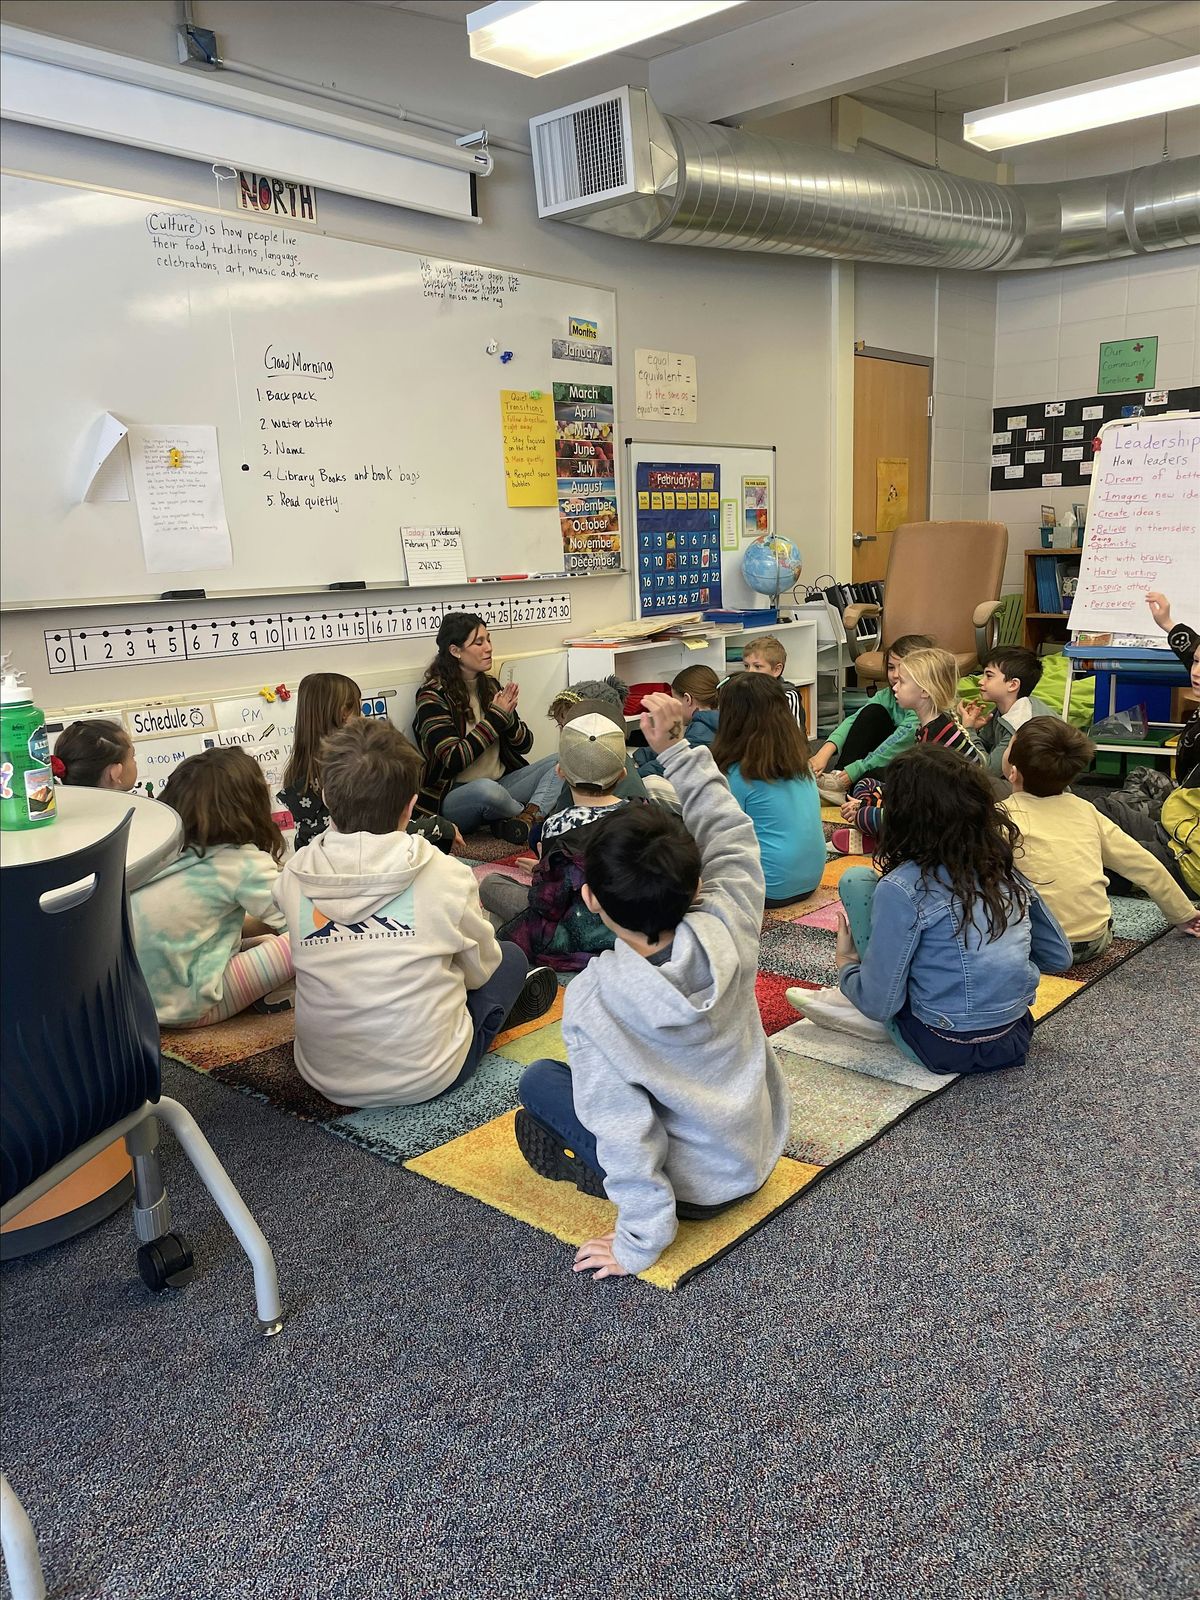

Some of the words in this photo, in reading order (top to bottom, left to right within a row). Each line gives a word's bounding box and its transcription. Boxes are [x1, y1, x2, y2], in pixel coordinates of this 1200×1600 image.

[239, 171, 314, 220] NORTH
[149, 213, 195, 234] Culture
[204, 225, 216, 235] is
[221, 220, 242, 238] how
[247, 230, 278, 246] people
[283, 230, 297, 246] live
[153, 236, 178, 250] their
[185, 238, 209, 257] food,
[156, 254, 220, 276] celebrations,
[226, 264, 245, 276] art,
[248, 265, 276, 277] music
[281, 269, 297, 278] and
[300, 272, 318, 280] more
[572, 325, 597, 339] Months
[564, 343, 602, 363] January
[1103, 345, 1123, 357] Our
[264, 344, 290, 370] Good
[292, 352, 334, 379] Morning
[647, 352, 670, 371] equal
[638, 369, 682, 386] equivalent
[266, 390, 318, 405] Backpack
[569, 385, 599, 400] March
[655, 388, 665, 400] the
[504, 401, 544, 413] Transitions
[574, 405, 596, 421] April
[304, 416, 334, 428] bottle
[574, 421, 596, 439] May
[262, 443, 272, 455] 3.
[275, 440, 305, 455] Name
[573, 442, 596, 456] June
[1115, 430, 1200, 453] Leadership
[1113, 454, 1133, 467] How
[1143, 451, 1189, 466] leaders
[277, 467, 315, 487] Library
[318, 468, 347, 483] Books
[354, 465, 370, 481] and
[371, 465, 393, 481] book
[576, 461, 595, 477] July
[1104, 472, 1144, 485] Dream
[1152, 467, 1167, 480] of
[571, 480, 603, 496] August
[657, 473, 692, 488] February
[279, 490, 301, 508] Read
[1103, 490, 1149, 505] Imagine
[564, 499, 612, 515] September
[1097, 507, 1128, 518] Create
[1132, 507, 1161, 517] ideas
[572, 517, 609, 532] October
[1096, 524, 1127, 535] Believe
[1148, 522, 1197, 535] themselves
[443, 538, 458, 548] 2025
[569, 537, 615, 551] November
[644, 536, 649, 547] 2
[656, 536, 662, 547] 3
[680, 535, 685, 545] 5
[691, 535, 697, 545] 6
[702, 534, 707, 544] 7
[711, 534, 717, 544] 8
[571, 555, 616, 569] December
[643, 557, 649, 567] 9
[655, 556, 663, 566] 10
[680, 555, 687, 565] 12
[691, 555, 699, 565] 13
[711, 553, 718, 563] 15
[1093, 555, 1108, 563] Act
[643, 577, 652, 587] 16
[656, 576, 665, 587] 17
[667, 575, 675, 586] 18
[679, 574, 687, 585] 19
[690, 574, 699, 584] 20
[702, 573, 709, 583] 21
[711, 572, 720, 582] 22
[1093, 567, 1118, 577] Hard
[1124, 568, 1158, 583] working
[1090, 584, 1122, 593] Inspire
[643, 597, 653, 608] 23
[656, 596, 666, 607] 24
[667, 595, 676, 605] 25
[679, 594, 688, 604] 26
[691, 593, 699, 603] 27
[1090, 599, 1136, 609] Persevere
[55, 647, 66, 663] 0
[104, 643, 114, 659] 2
[126, 641, 135, 657] 3
[147, 639, 156, 654] 4
[168, 637, 177, 653] 5
[192, 635, 201, 650] 6
[211, 633, 220, 648] 7
[231, 632, 239, 647] 8
[250, 630, 258, 645] 9
[266, 628, 279, 643] 10
[287, 627, 298, 642] 11
[304, 625, 316, 640] 12
[321, 624, 333, 639] 13
[337, 623, 349, 637] 14
[353, 621, 365, 636] 15
[371, 620, 383, 634] 16
[387, 618, 398, 633] 17
[401, 617, 412, 632] 18
[416, 616, 427, 630] 19
[430, 615, 441, 629] 20
[485, 610, 496, 624] 24
[498, 609, 509, 623] 25
[513, 608, 523, 622] 26
[525, 607, 535, 621] 27
[537, 606, 546, 619] 28
[548, 605, 558, 618] 29
[559, 604, 570, 618] 30
[134, 707, 189, 733] Schedule
[241, 708, 264, 723] PM
[217, 731, 256, 746] Lunch
[172, 751, 187, 762] AM
[369, 930, 416, 940] OUTDOORS
